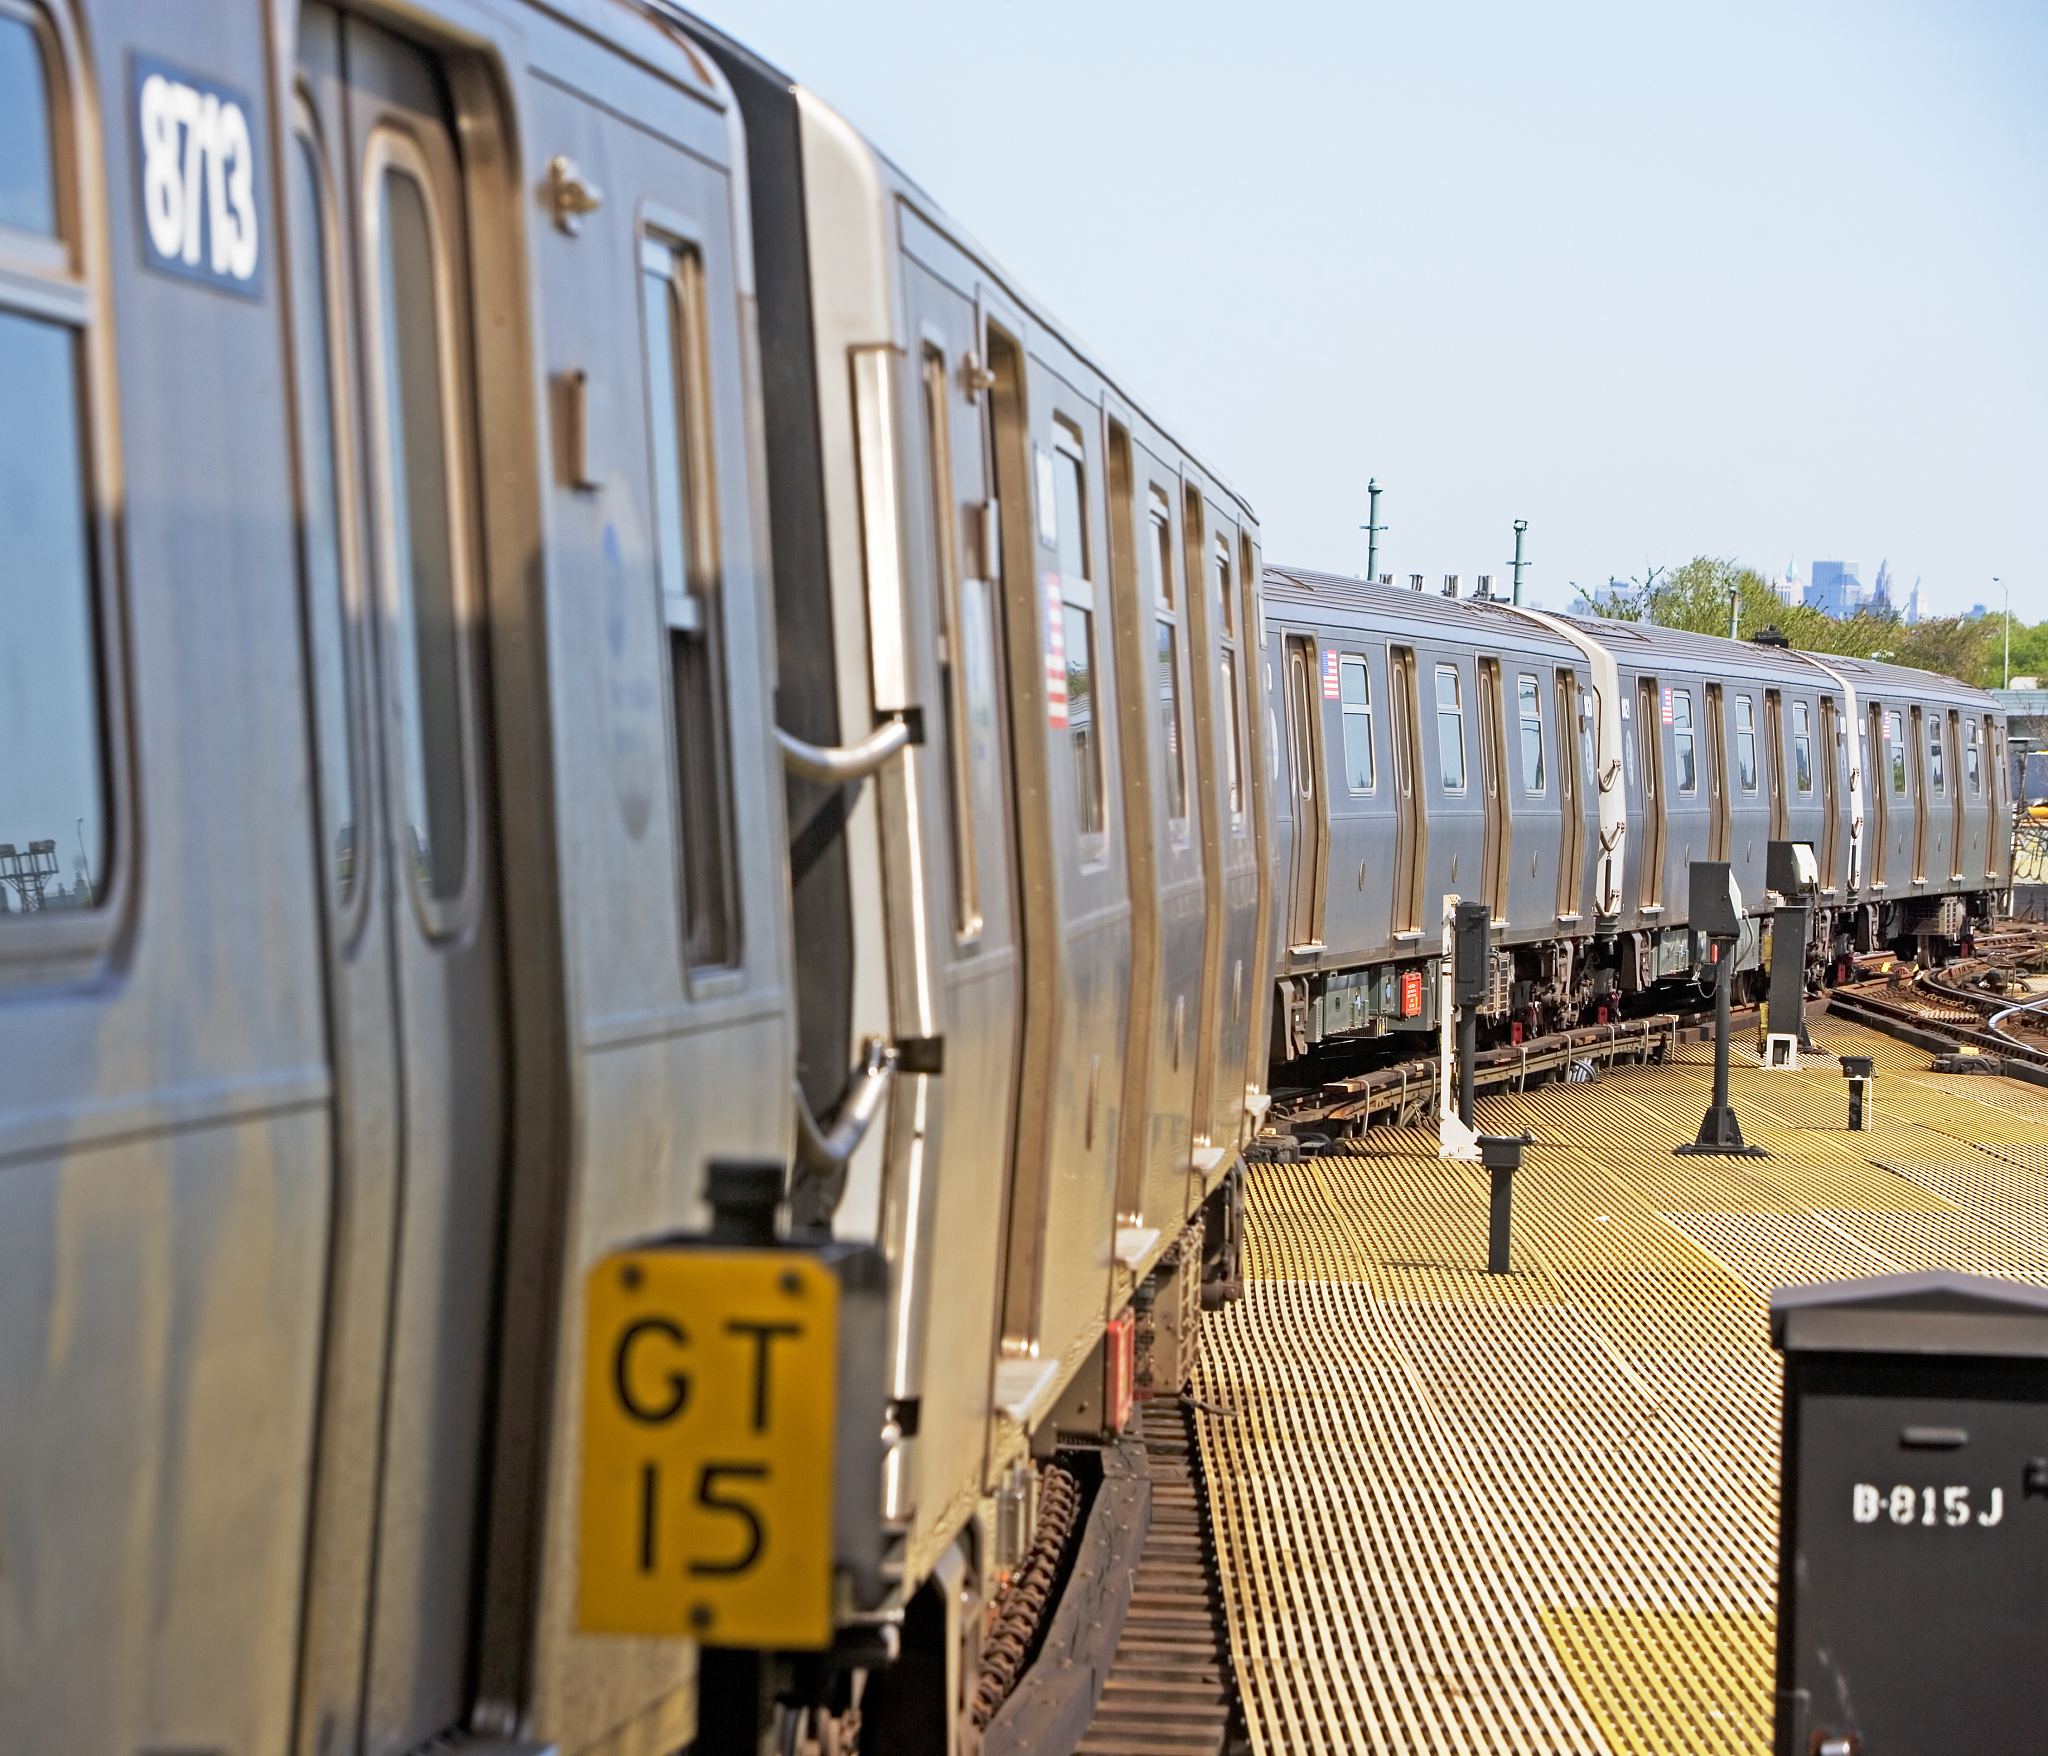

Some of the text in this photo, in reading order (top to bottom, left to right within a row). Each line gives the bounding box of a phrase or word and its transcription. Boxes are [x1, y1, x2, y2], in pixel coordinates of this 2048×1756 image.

[140, 73, 258, 280] 8713
[613, 1315, 804, 1436] GT
[638, 1457, 771, 1579] 15
